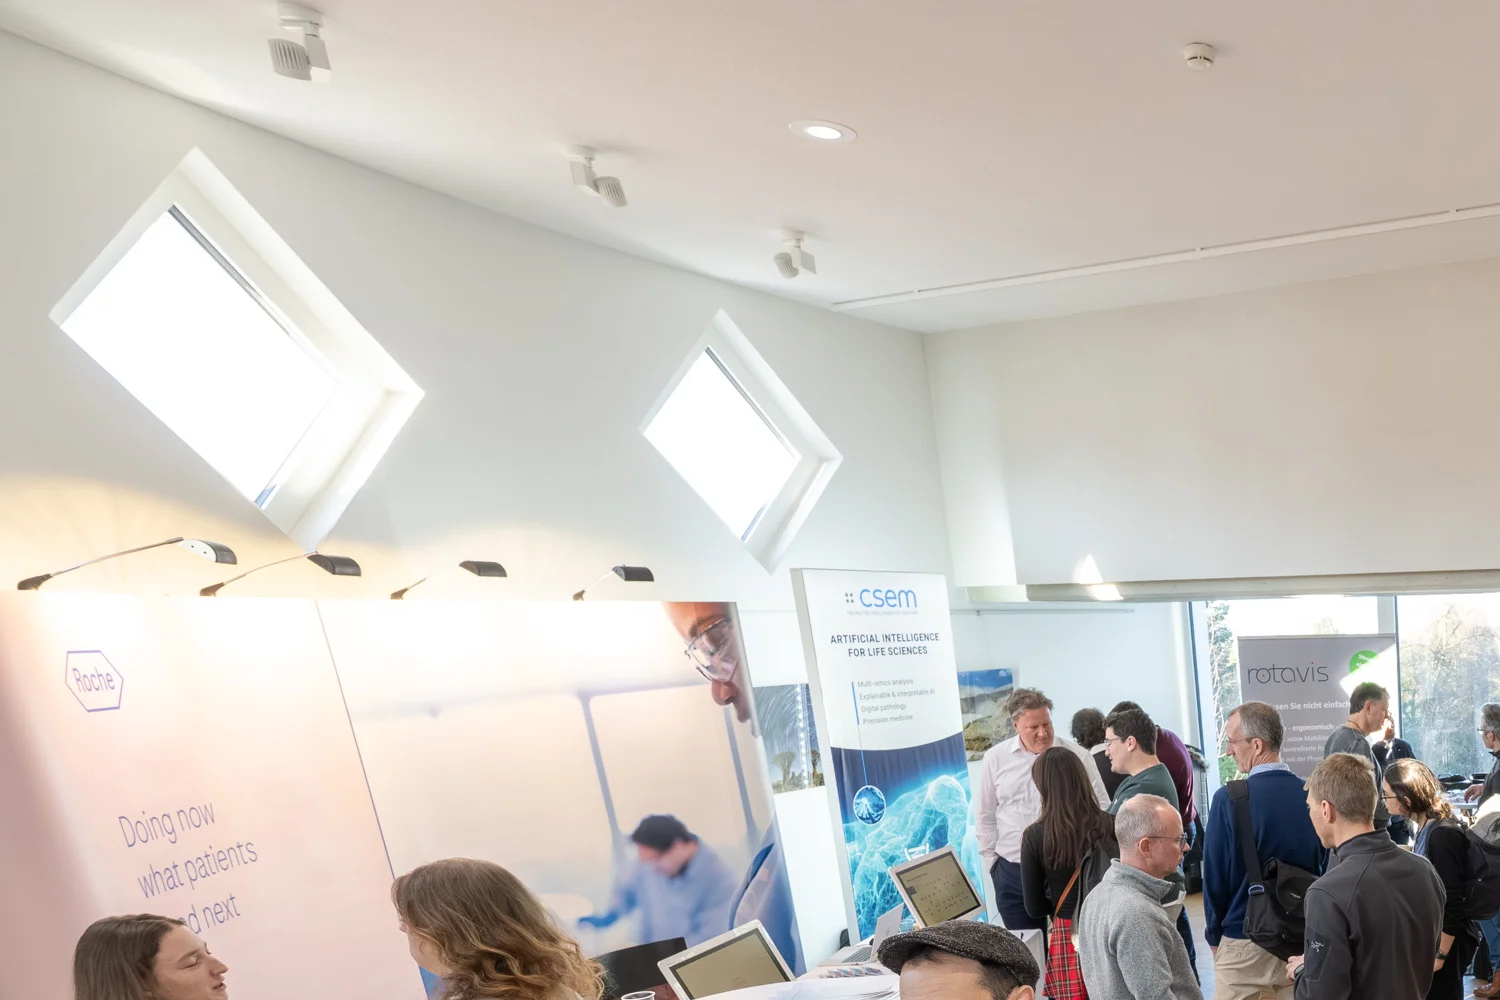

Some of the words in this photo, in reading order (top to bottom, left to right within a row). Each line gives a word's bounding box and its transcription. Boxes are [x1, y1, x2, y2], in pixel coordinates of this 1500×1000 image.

[860, 589, 917, 608] csem
[830, 634, 880, 644] ARTIFICIAL
[882, 632, 940, 642] INTELLIGENCE
[848, 648, 866, 657] FOR
[868, 647, 886, 656] LIFE
[887, 645, 928, 656] SCIENCES
[72, 666, 115, 692] Roche
[1247, 662, 1329, 684] rotavis
[859, 691, 891, 700] Explainable
[861, 705, 879, 713] Digital
[880, 703, 907, 711] pathology
[1290, 702, 1302, 710] Sie
[1303, 701, 1322, 710] nicht
[1323, 701, 1350, 709] einfach
[863, 716, 889, 724] Precision
[1292, 723, 1334, 732] ergonomisch
[118, 810, 177, 847] Doing
[177, 803, 215, 831] now
[137, 861, 184, 899] what
[184, 841, 258, 890] patients
[202, 893, 241, 929] next
